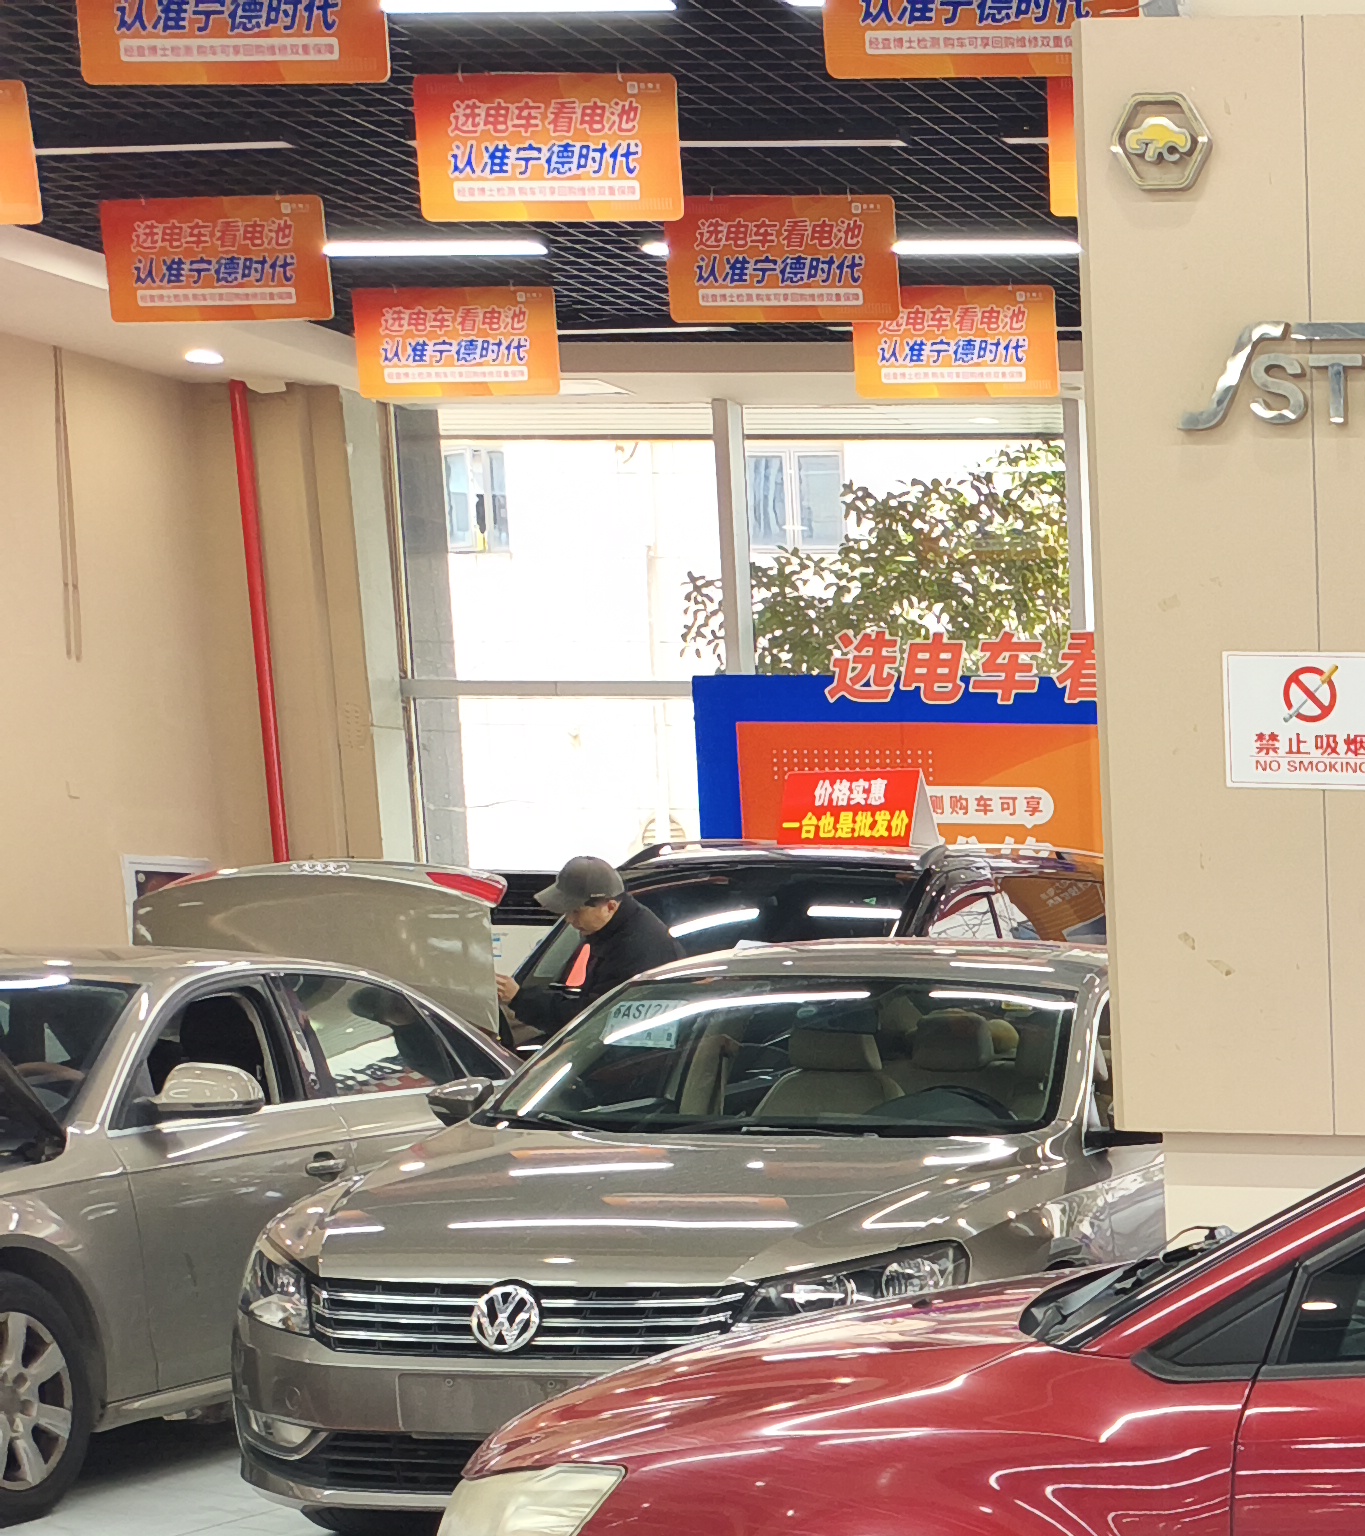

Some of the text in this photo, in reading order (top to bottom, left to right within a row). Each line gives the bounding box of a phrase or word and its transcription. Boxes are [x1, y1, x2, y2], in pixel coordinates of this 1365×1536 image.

[114, 0, 340, 34] 认准宁德时代
[449, 98, 641, 137] 选电车 看电池
[449, 141, 641, 178] 认准宁德时代
[132, 217, 295, 252] 选电车 看电池
[694, 217, 865, 252] 选电车 看电池
[133, 253, 297, 288] 认准宁德时代
[694, 253, 866, 287] 认准宁德时代
[380, 304, 528, 335] 选电车 看电池
[954, 304, 1028, 334] 看电池
[381, 337, 530, 368] 认准宁德时代
[878, 337, 1029, 367] 认准宁德时代
[825, 629, 1045, 705] 选电车
[1255, 759, 1281, 773] NO
[814, 778, 888, 807] 价格实惠
[782, 809, 909, 839] 一台也是批发价
